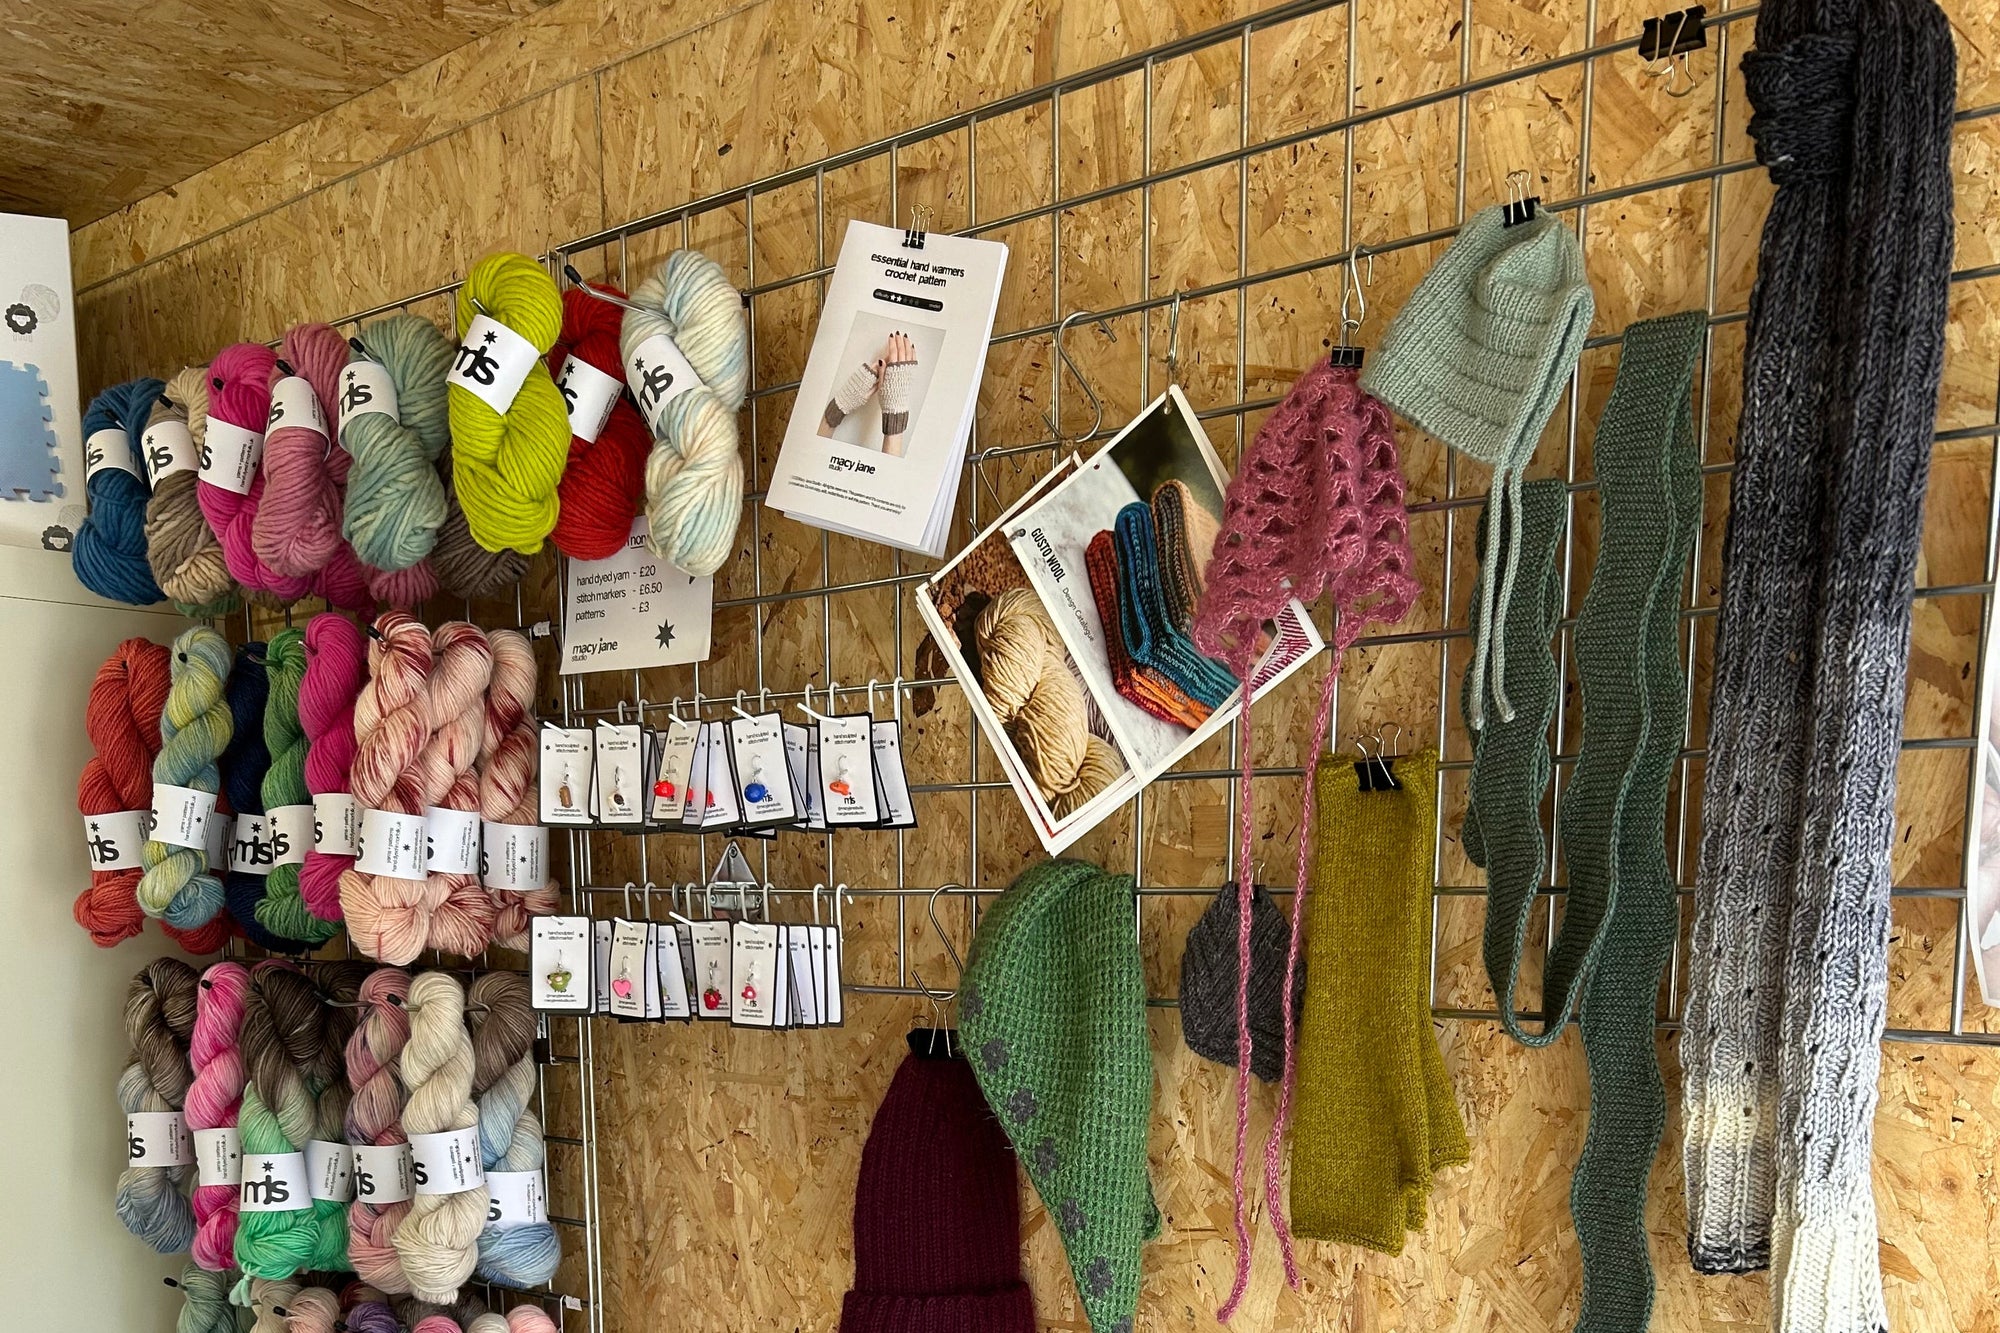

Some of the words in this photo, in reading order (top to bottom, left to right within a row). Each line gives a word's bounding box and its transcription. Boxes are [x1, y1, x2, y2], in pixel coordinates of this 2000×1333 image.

[871, 253, 909, 269] essential
[910, 260, 931, 273] hand
[932, 264, 965, 278] warmers
[885, 268, 917, 283] crochet
[918, 275, 947, 287] pattern
[828, 464, 843, 472] studio
[830, 455, 855, 471] macy
[855, 460, 876, 475] jane
[1031, 527, 1053, 557] GUSTO
[1046, 554, 1066, 583] WOOL
[576, 572, 593, 586] hand
[595, 571, 612, 586] dyed
[613, 571, 630, 584] yarn
[639, 565, 656, 577] £20
[576, 592, 596, 604] stitch
[596, 589, 626, 601] markers
[639, 581, 663, 595] £6.50
[575, 609, 606, 623] patterns
[638, 601, 650, 613] £3
[1062, 587, 1077, 611] Design
[1074, 609, 1094, 642] Catalogue
[572, 643, 598, 656] macy
[598, 637, 618, 655] jane
[571, 654, 588, 662] studio
[244, 1174, 290, 1205] mjs
